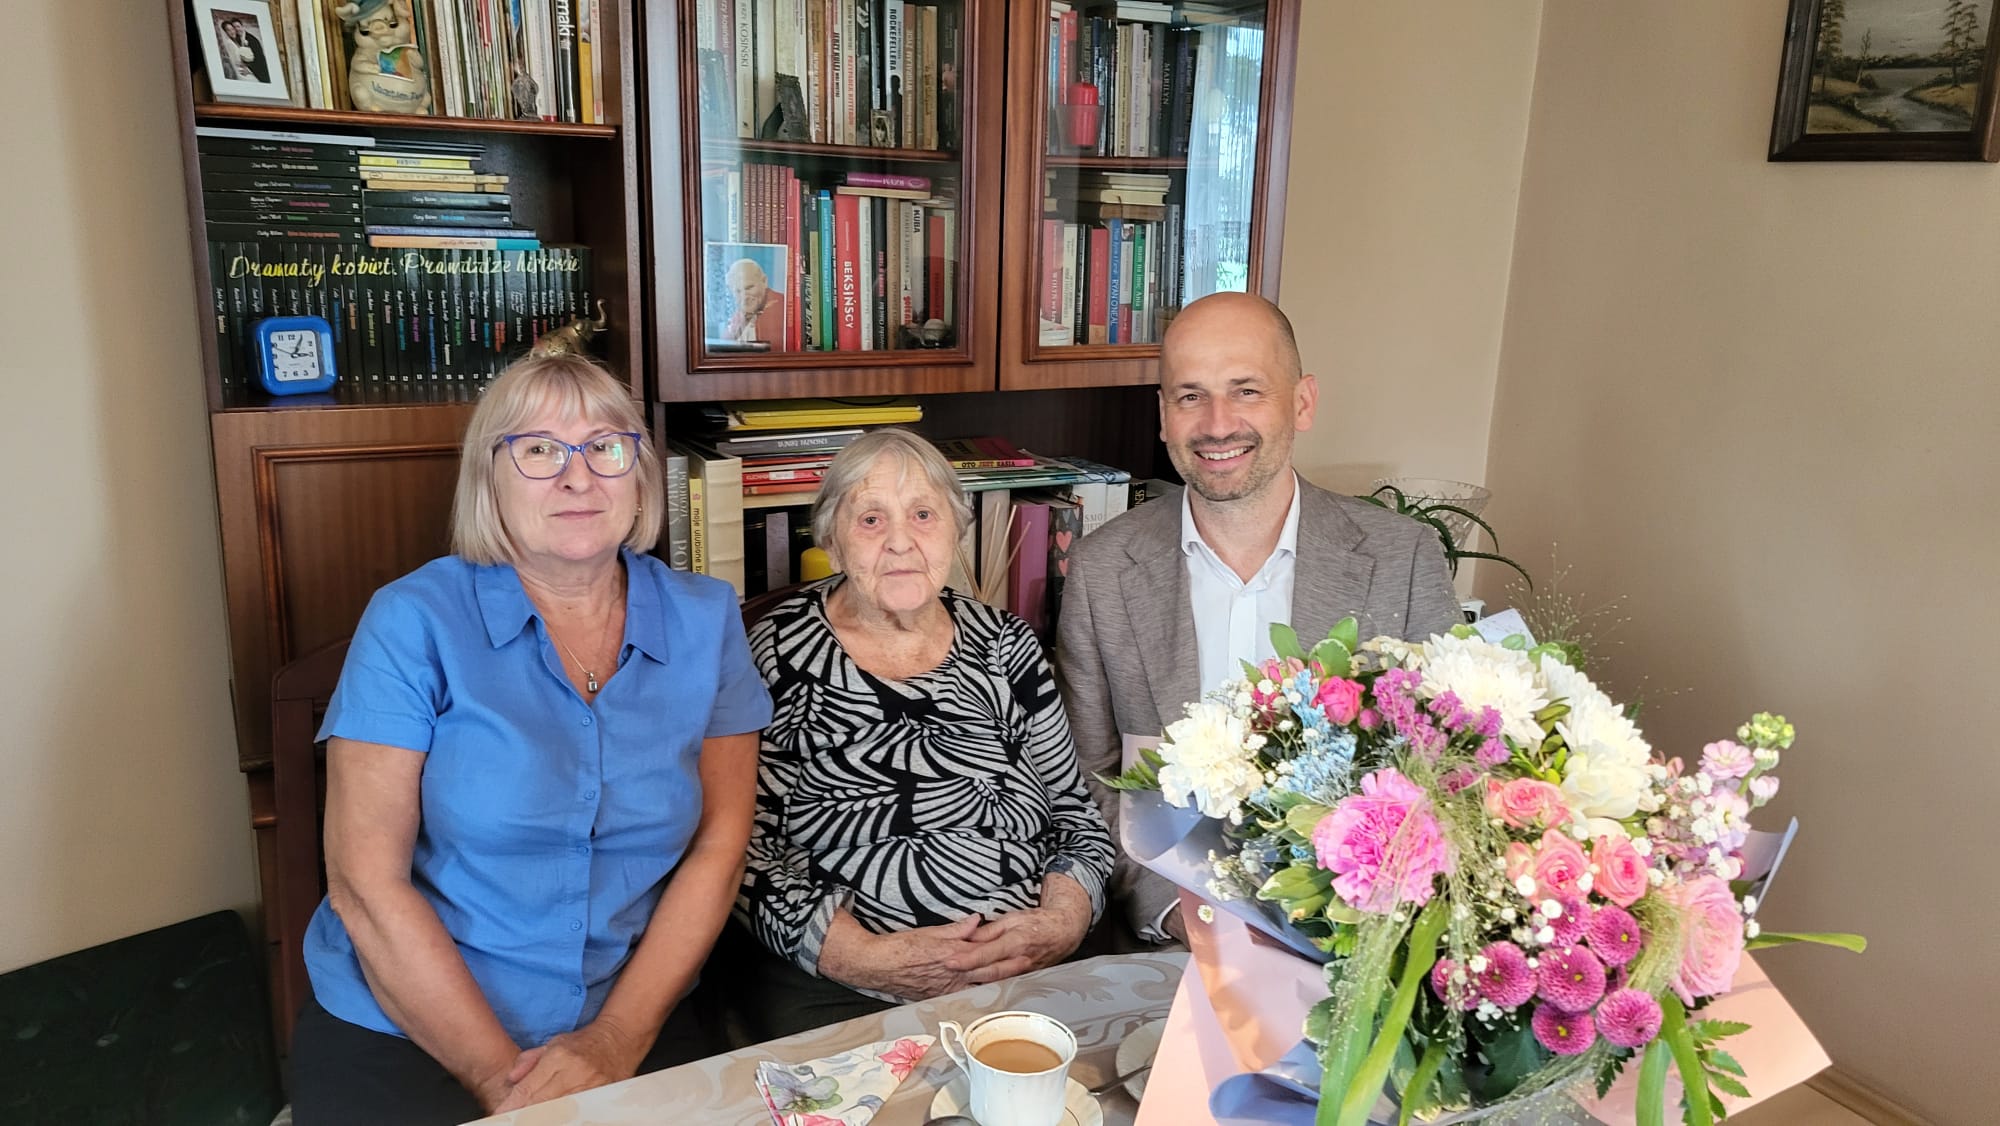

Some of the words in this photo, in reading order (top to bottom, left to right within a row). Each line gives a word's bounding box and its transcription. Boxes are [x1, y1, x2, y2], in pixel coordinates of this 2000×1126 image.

[740, 23, 750, 67] KOSIŃSKI
[889, 9, 897, 71] ROCKEFELLERA
[1162, 62, 1170, 105] MARILYN
[913, 209, 921, 233] KUBA
[229, 255, 325, 287] Dramaty
[843, 260, 857, 329] BEKSIŃSCY
[692, 508, 701, 527] moje
[694, 529, 703, 563] ulubione
